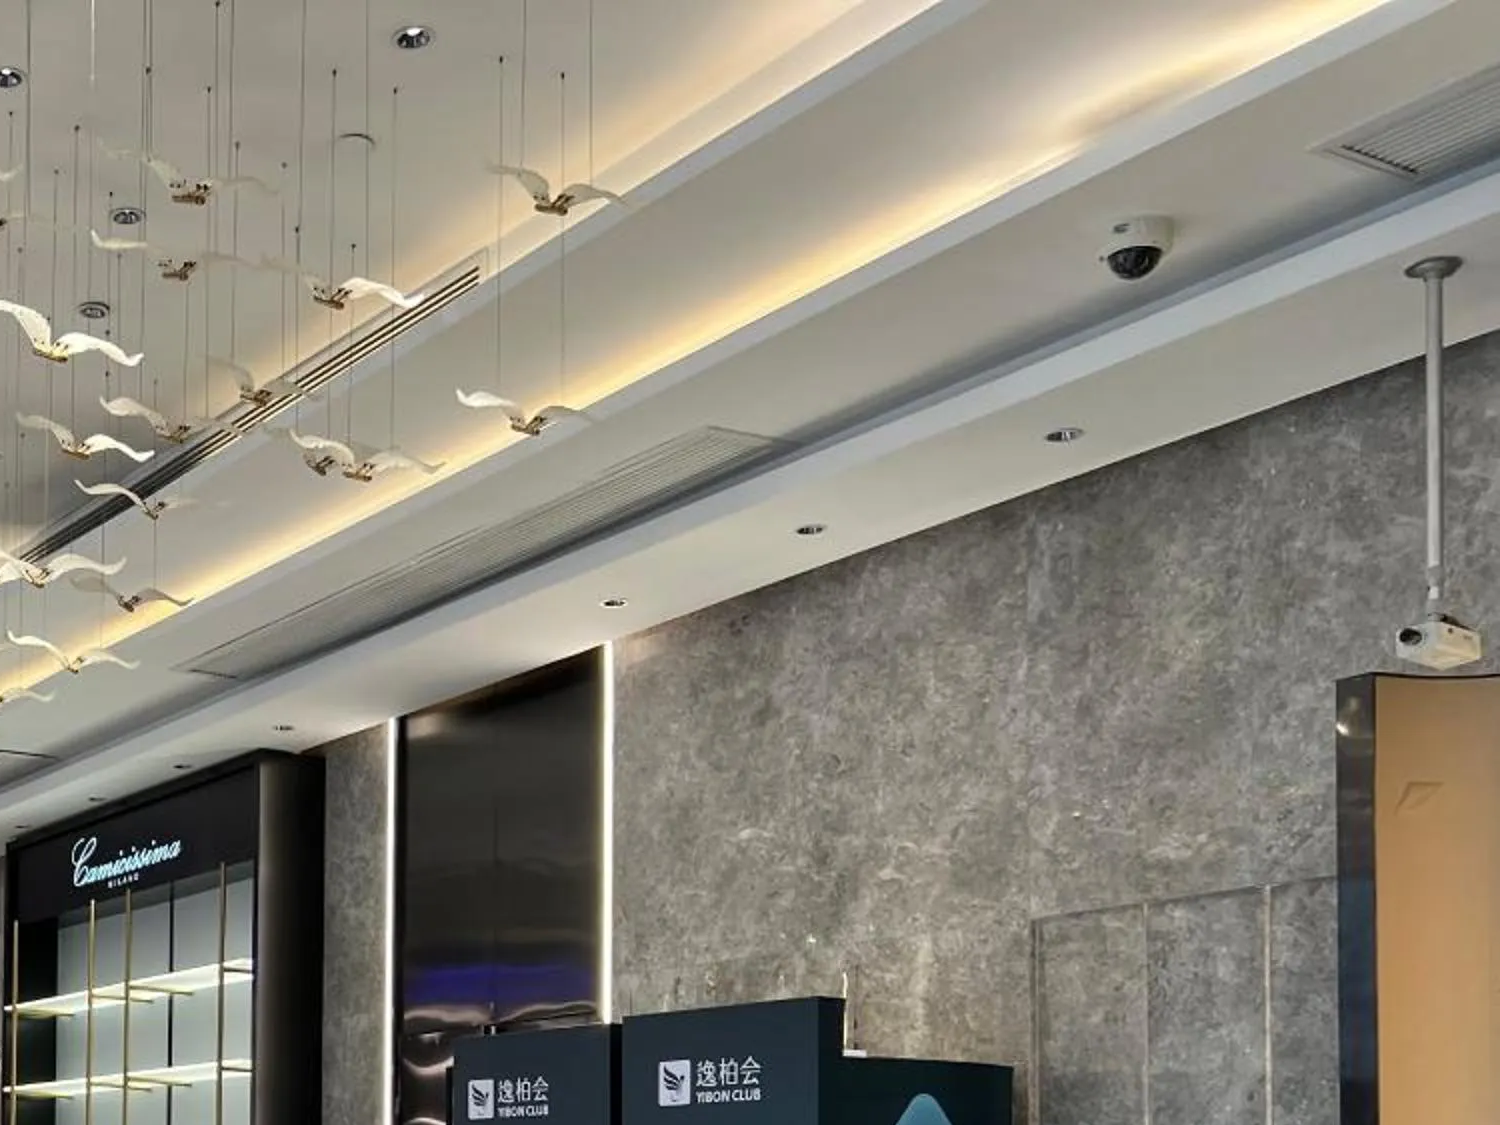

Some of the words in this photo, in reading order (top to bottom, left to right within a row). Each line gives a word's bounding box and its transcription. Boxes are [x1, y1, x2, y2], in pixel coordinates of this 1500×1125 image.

[695, 1055, 762, 1087] 逸柏会
[497, 1075, 549, 1103] 逸柏会
[695, 1090, 731, 1104] YIBON
[732, 1087, 762, 1102] CLUB
[497, 1104, 525, 1118] YIBON
[526, 1103, 549, 1117] CLUB
